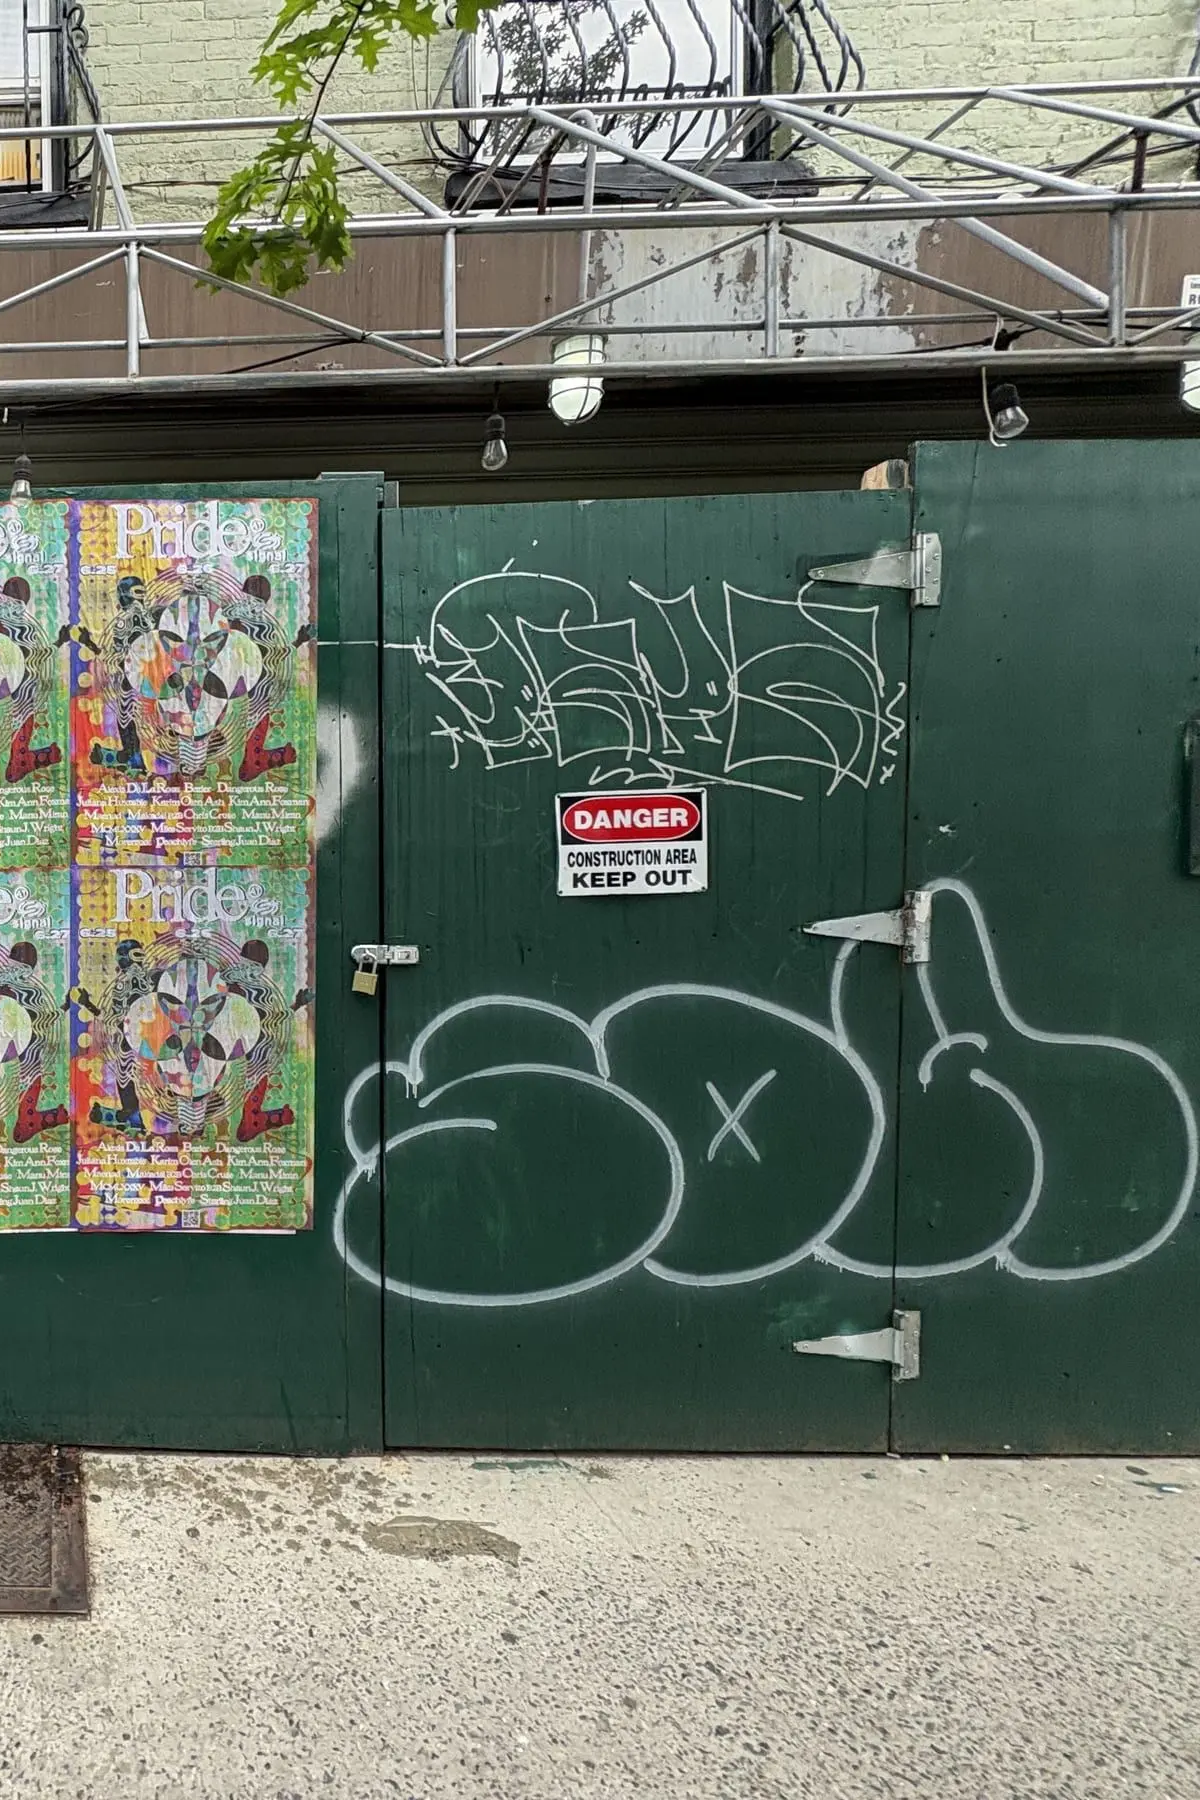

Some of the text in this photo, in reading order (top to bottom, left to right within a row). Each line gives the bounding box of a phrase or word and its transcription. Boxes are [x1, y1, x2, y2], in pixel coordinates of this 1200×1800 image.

[110, 500, 250, 560] Pride
[31, 781, 54, 792] Rose
[217, 782, 264, 793] Dangerous
[265, 782, 288, 792] Rose
[17, 795, 38, 806] Ann
[228, 795, 248, 806] Kim
[249, 795, 271, 806] Ann
[573, 807, 689, 830] DANGER
[567, 848, 697, 868] CONSTRUCTION AREA
[572, 869, 692, 889] KEEP OUT
[109, 866, 248, 924] Pride
[4, 1156, 23, 1167] Kim
[24, 1156, 46, 1166] Ann
[226, 1155, 246, 1166] Kim
[247, 1155, 269, 1166] Ann
